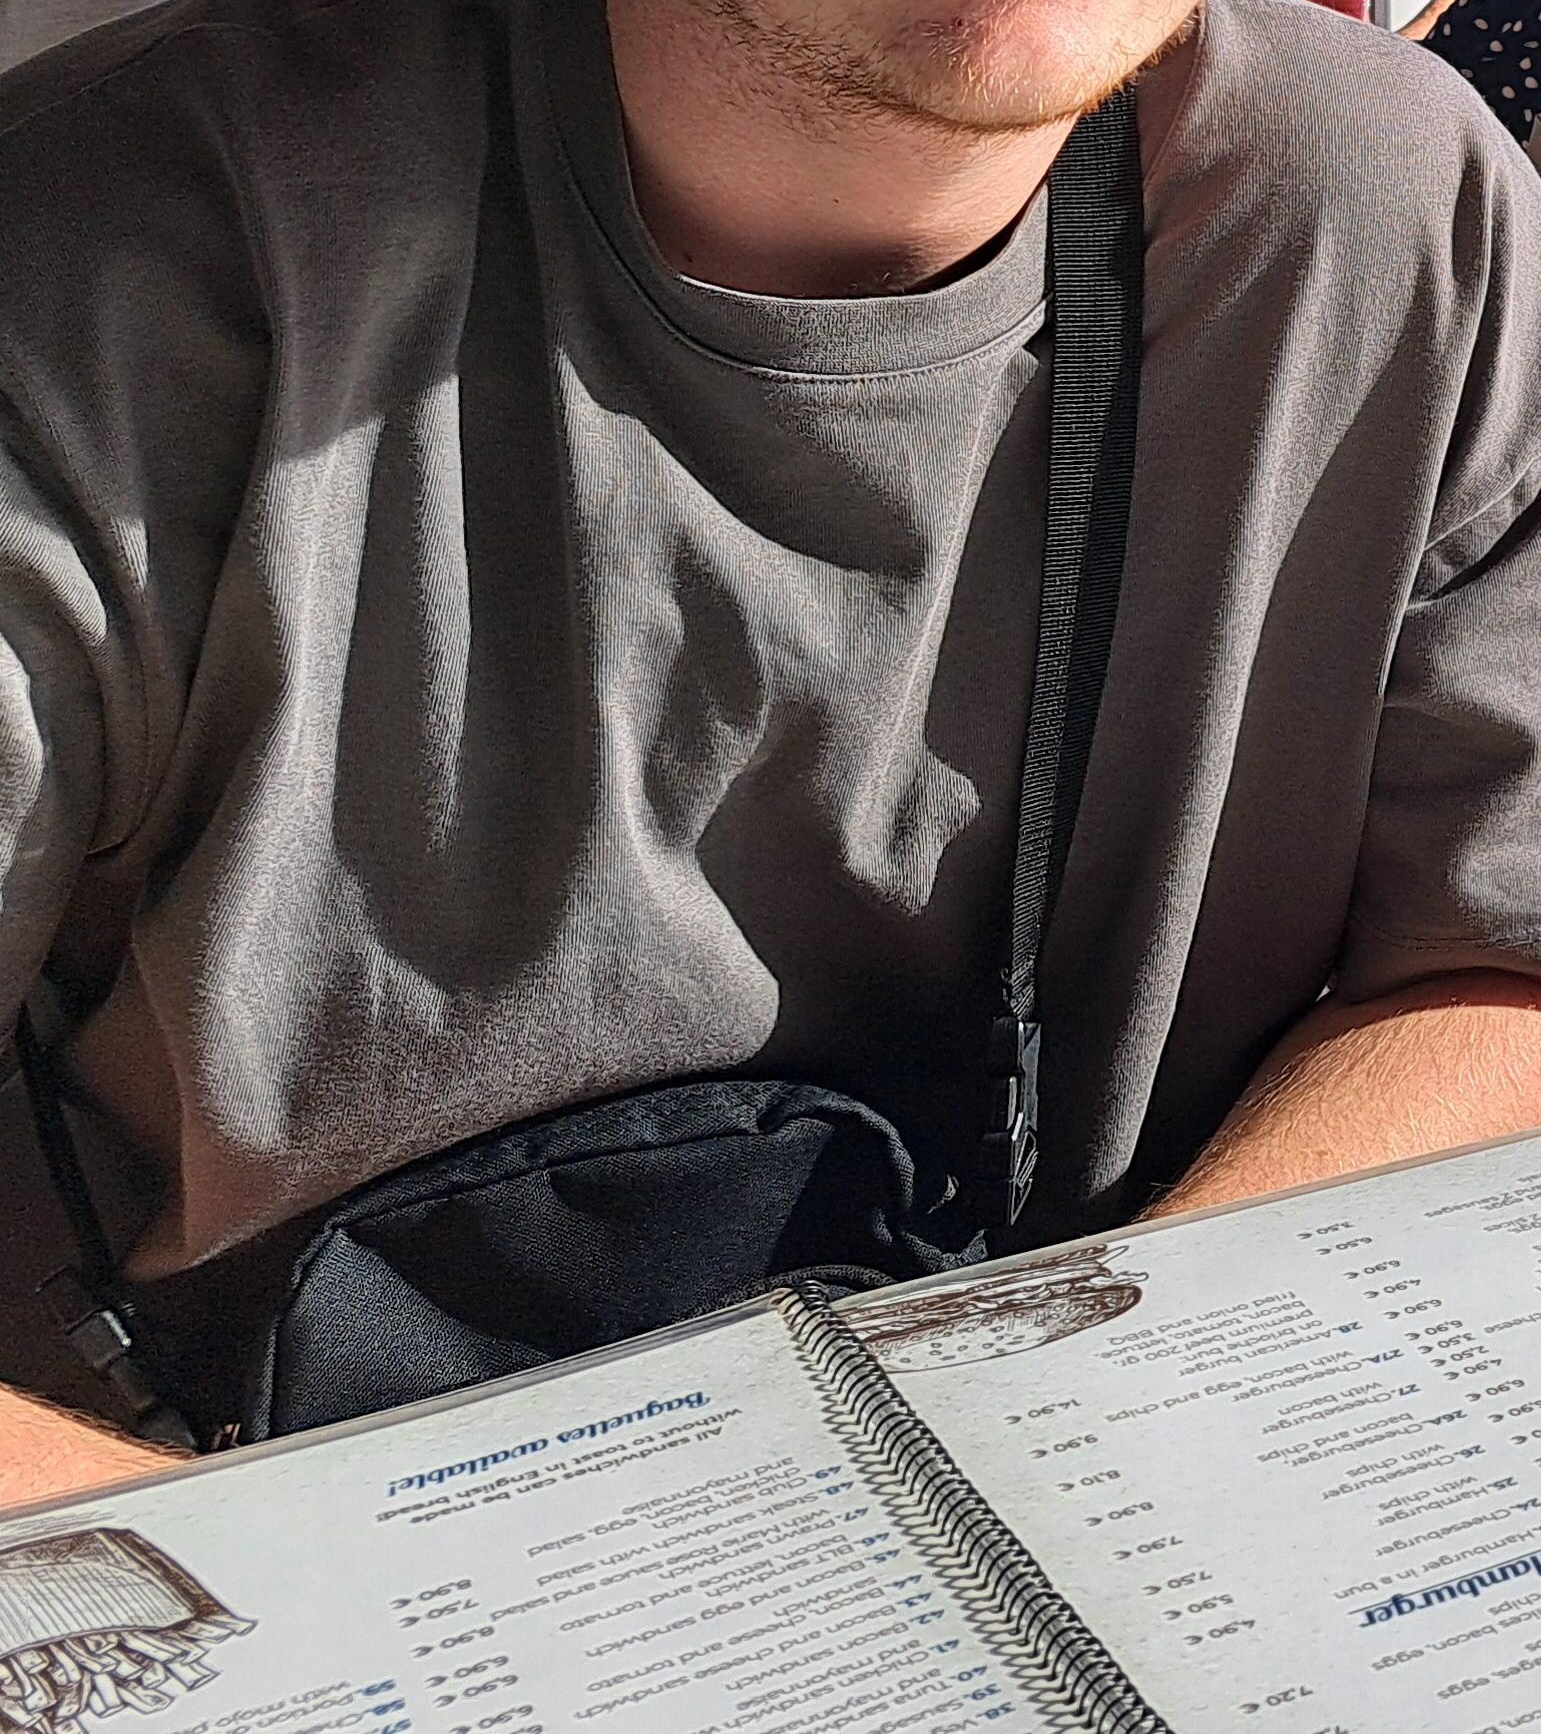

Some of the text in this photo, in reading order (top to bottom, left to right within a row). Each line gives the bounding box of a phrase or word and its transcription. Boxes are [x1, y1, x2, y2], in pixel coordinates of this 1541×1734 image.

[1106, 1290, 1296, 1345] fried onion and BBQ
[1227, 1307, 1314, 1337] premium
[1241, 1299, 1306, 1319] bacon,
[1167, 1316, 1243, 1339] tomato,
[1225, 1326, 1297, 1350] brioche
[1297, 1319, 1323, 1331] on
[1143, 1344, 1183, 1361] 200
[1183, 1333, 1226, 1351] beef
[1243, 1328, 1331, 1358] American
[1178, 1354, 1243, 1376] burger
[1104, 1350, 1353, 1422] with bacon, egg and chips
[1232, 1360, 1362, 1402] Cheeseburger
[1003, 1397, 1082, 1425] 14,90 €
[1261, 1391, 1392, 1434] Cheeseburger
[1277, 1381, 1383, 1415] with bacon
[657, 1407, 743, 1438] without
[1256, 1411, 1414, 1462] bacon and chips
[386, 1390, 711, 1497] Baguettes available!
[570, 1443, 629, 1465] toast
[630, 1434, 655, 1446] to
[1029, 1433, 1098, 1459] 9,90 €
[1282, 1422, 1423, 1467] Cheeseburger,
[408, 1425, 723, 1524] All sandwiches can be made
[543, 1461, 568, 1472] in
[1344, 1443, 1445, 1477] with chips
[454, 1469, 540, 1498] English
[621, 1456, 794, 1515] and mayonnaise
[757, 1476, 808, 1496] Club
[1055, 1469, 1121, 1492] 8,10 €
[1321, 1454, 1455, 1500] Cheeseburger
[1376, 1475, 1478, 1511] with chips
[1377, 1485, 1489, 1526] Hamburger
[526, 1466, 801, 1558] chicken, bacon, egg, salad
[650, 1492, 755, 1529] sandwich
[1083, 1500, 1154, 1527] 8,90 €
[1375, 1508, 1511, 1556] Cheeseburger
[1112, 1535, 1183, 1560] 7,90 €
[1421, 1529, 1535, 1572] Hamburger
[558, 1533, 848, 1631] bacon, lettuce and tomato
[1141, 1570, 1213, 1596] 7,50 €
[1378, 1575, 1393, 1585] a
[1395, 1568, 1419, 1579] in
[389, 1578, 472, 1610] 8,90 €
[1333, 1581, 1378, 1599] bun
[1487, 1592, 1541, 1616] chips
[1162, 1593, 1234, 1620] 5,90 €
[1183, 1618, 1256, 1646] 4,90 €
[1424, 1624, 1498, 1651] bacon,
[424, 1654, 509, 1688] 6,90 €
[1370, 1649, 1425, 1671] eggs
[1238, 1685, 1314, 1714] 7,20 €
